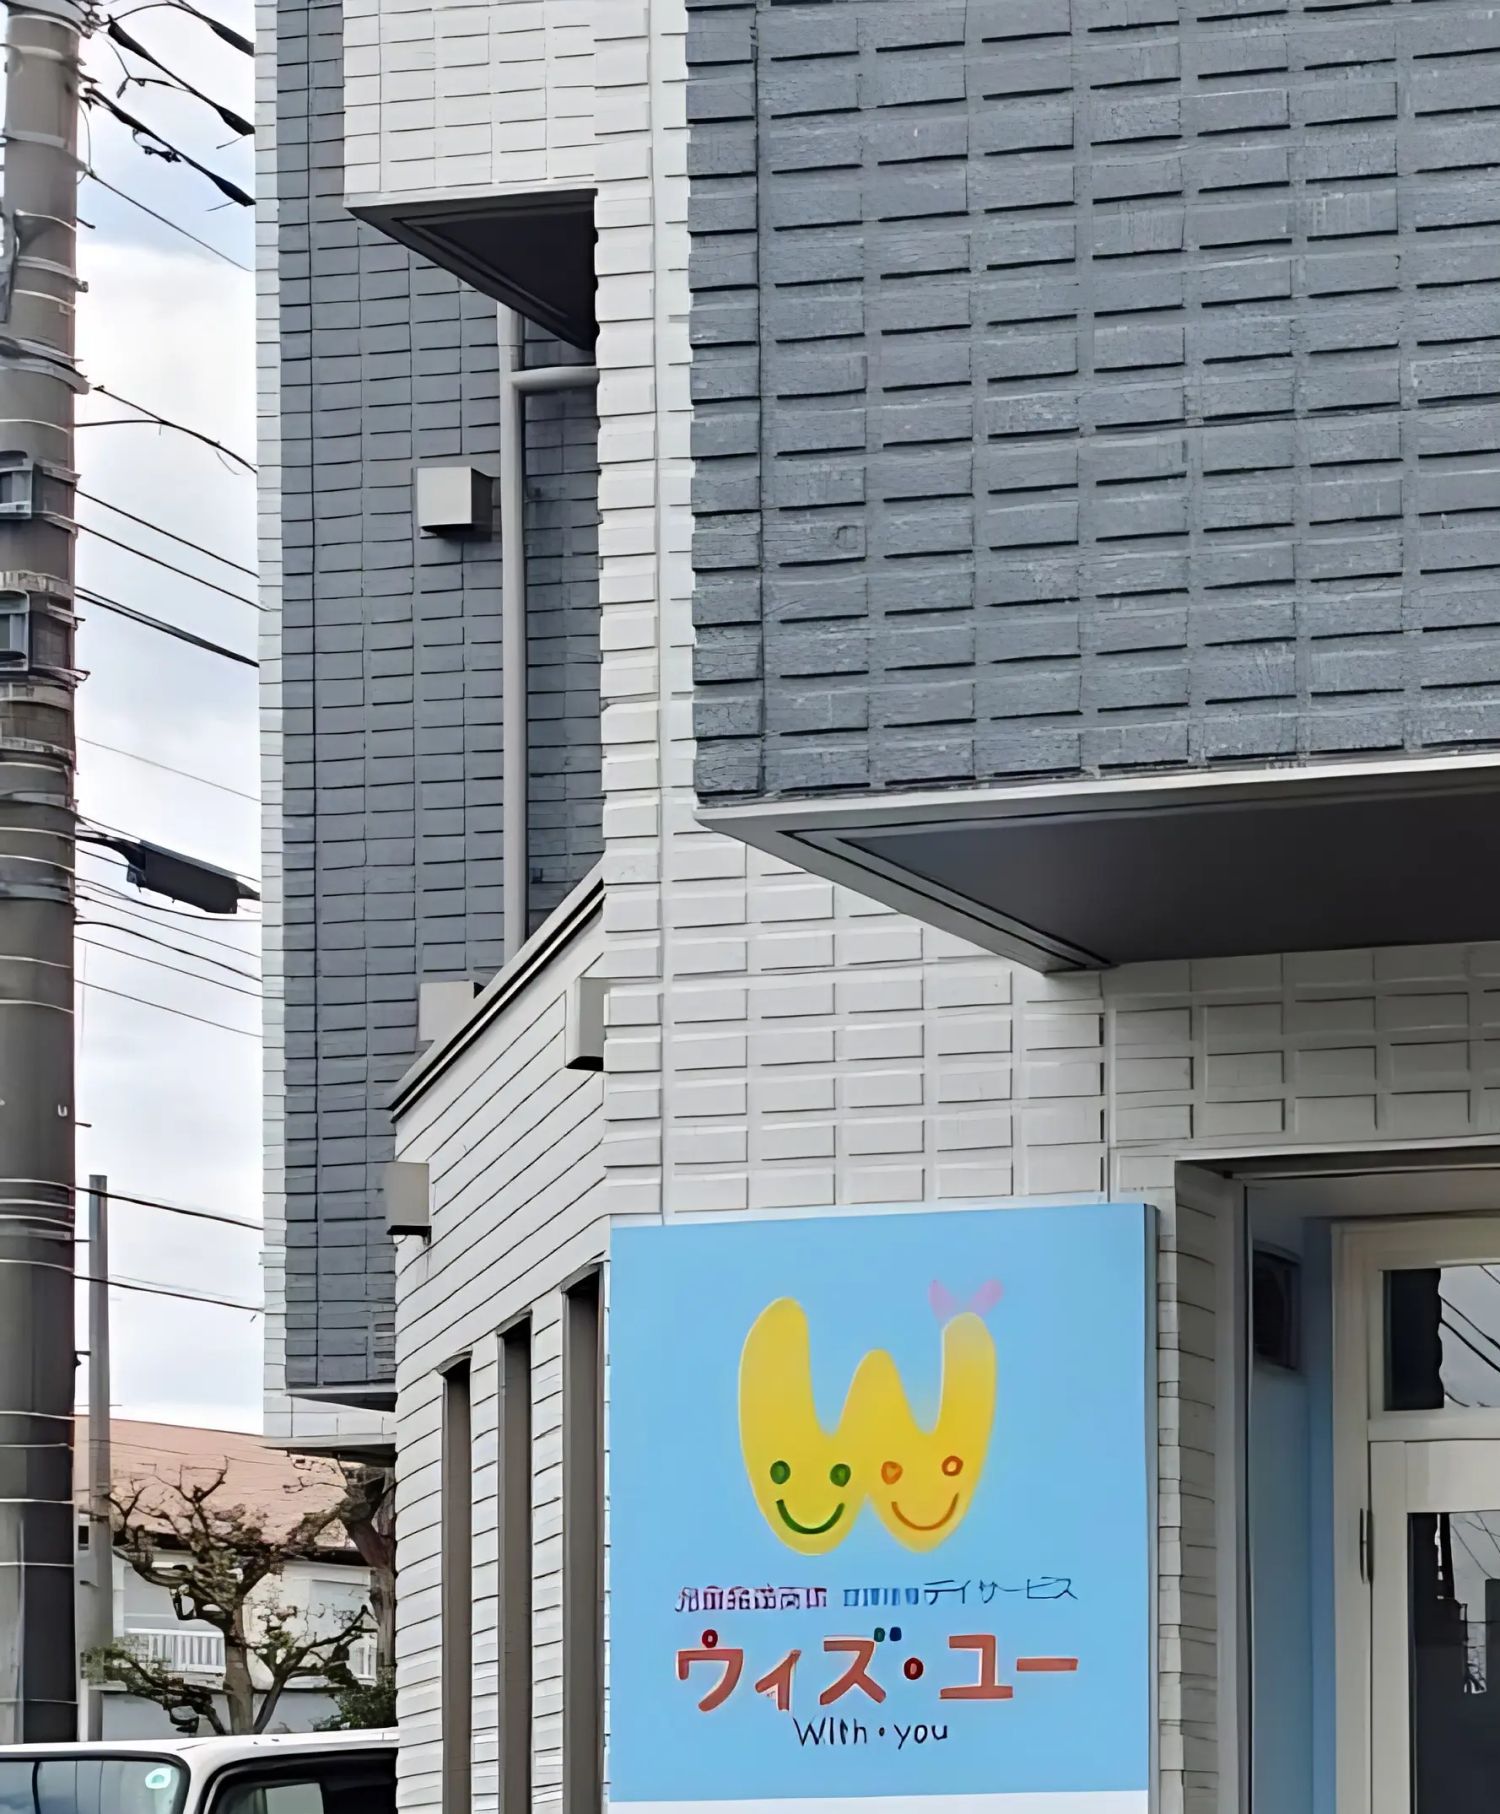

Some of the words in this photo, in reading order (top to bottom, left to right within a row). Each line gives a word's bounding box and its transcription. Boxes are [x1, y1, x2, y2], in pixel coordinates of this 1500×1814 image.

[843, 1577, 1078, 1607] デイサービス
[676, 1627, 1079, 1712] ウィズ・ユー
